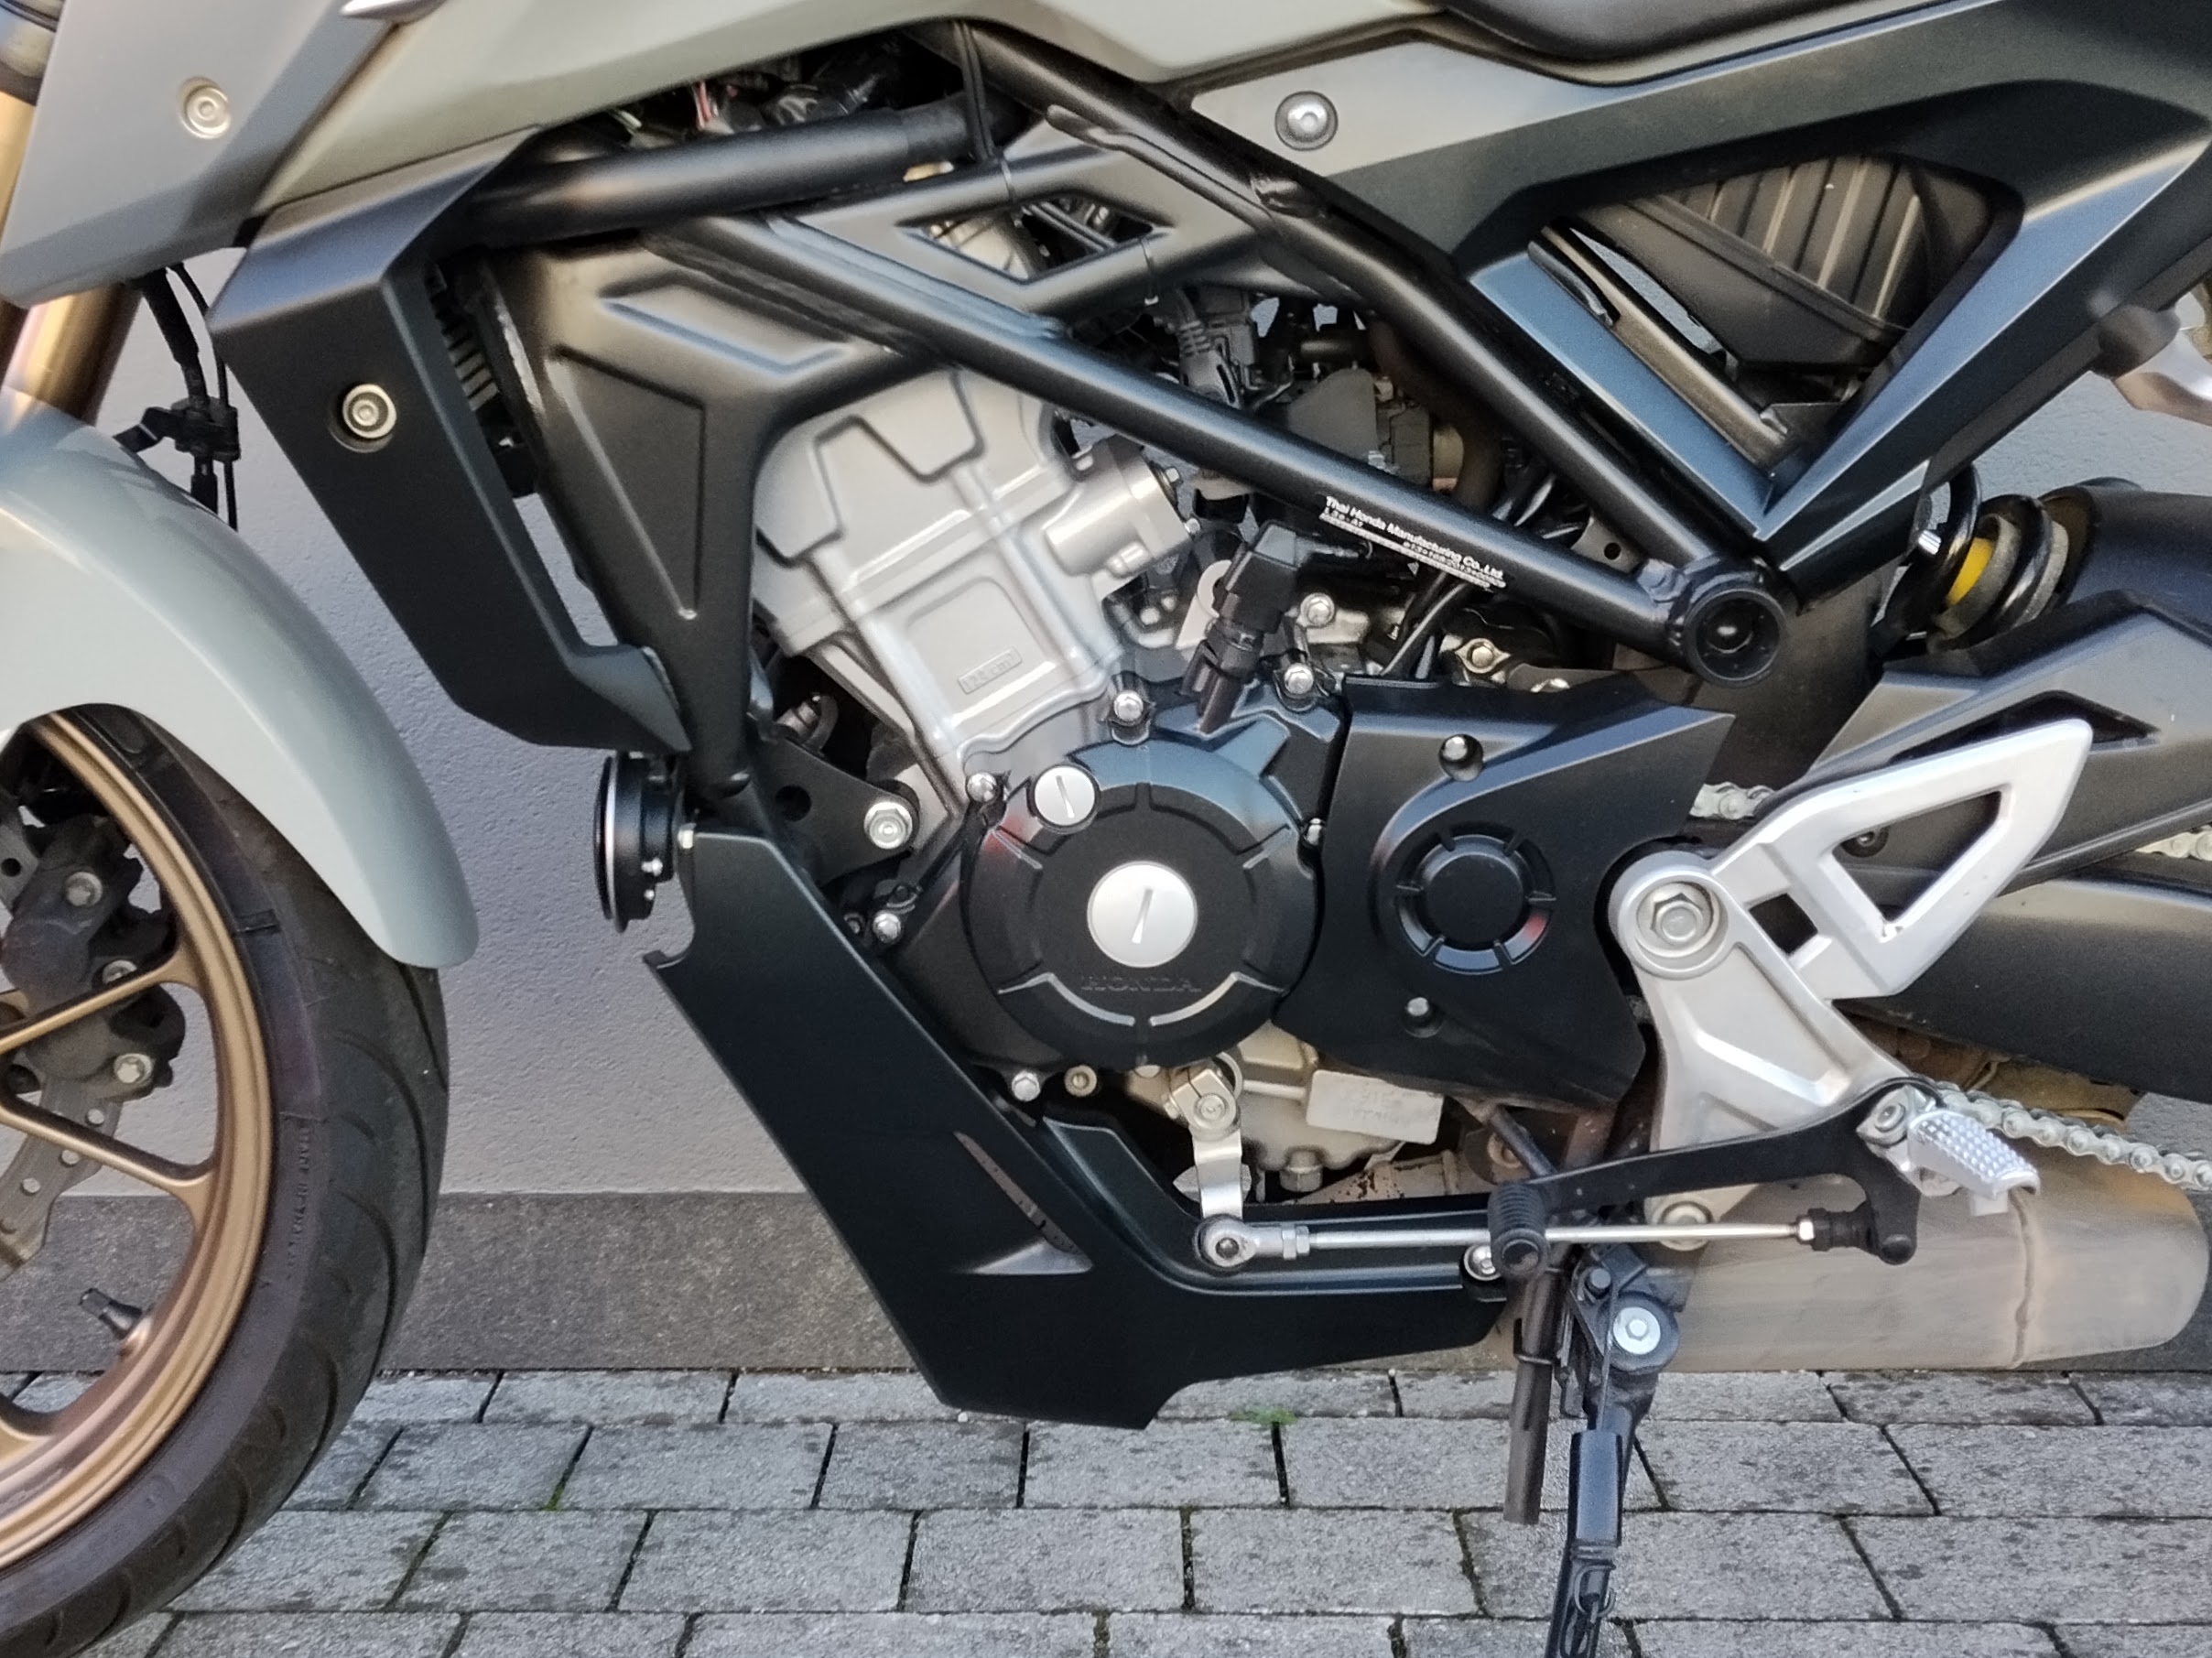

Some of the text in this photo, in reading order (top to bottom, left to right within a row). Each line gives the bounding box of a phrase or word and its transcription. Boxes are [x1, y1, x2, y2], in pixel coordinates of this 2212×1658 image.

[1350, 506, 1387, 531] Honda
[1386, 523, 1462, 564] Manufacturing
[1080, 975, 1202, 992] HONDA
